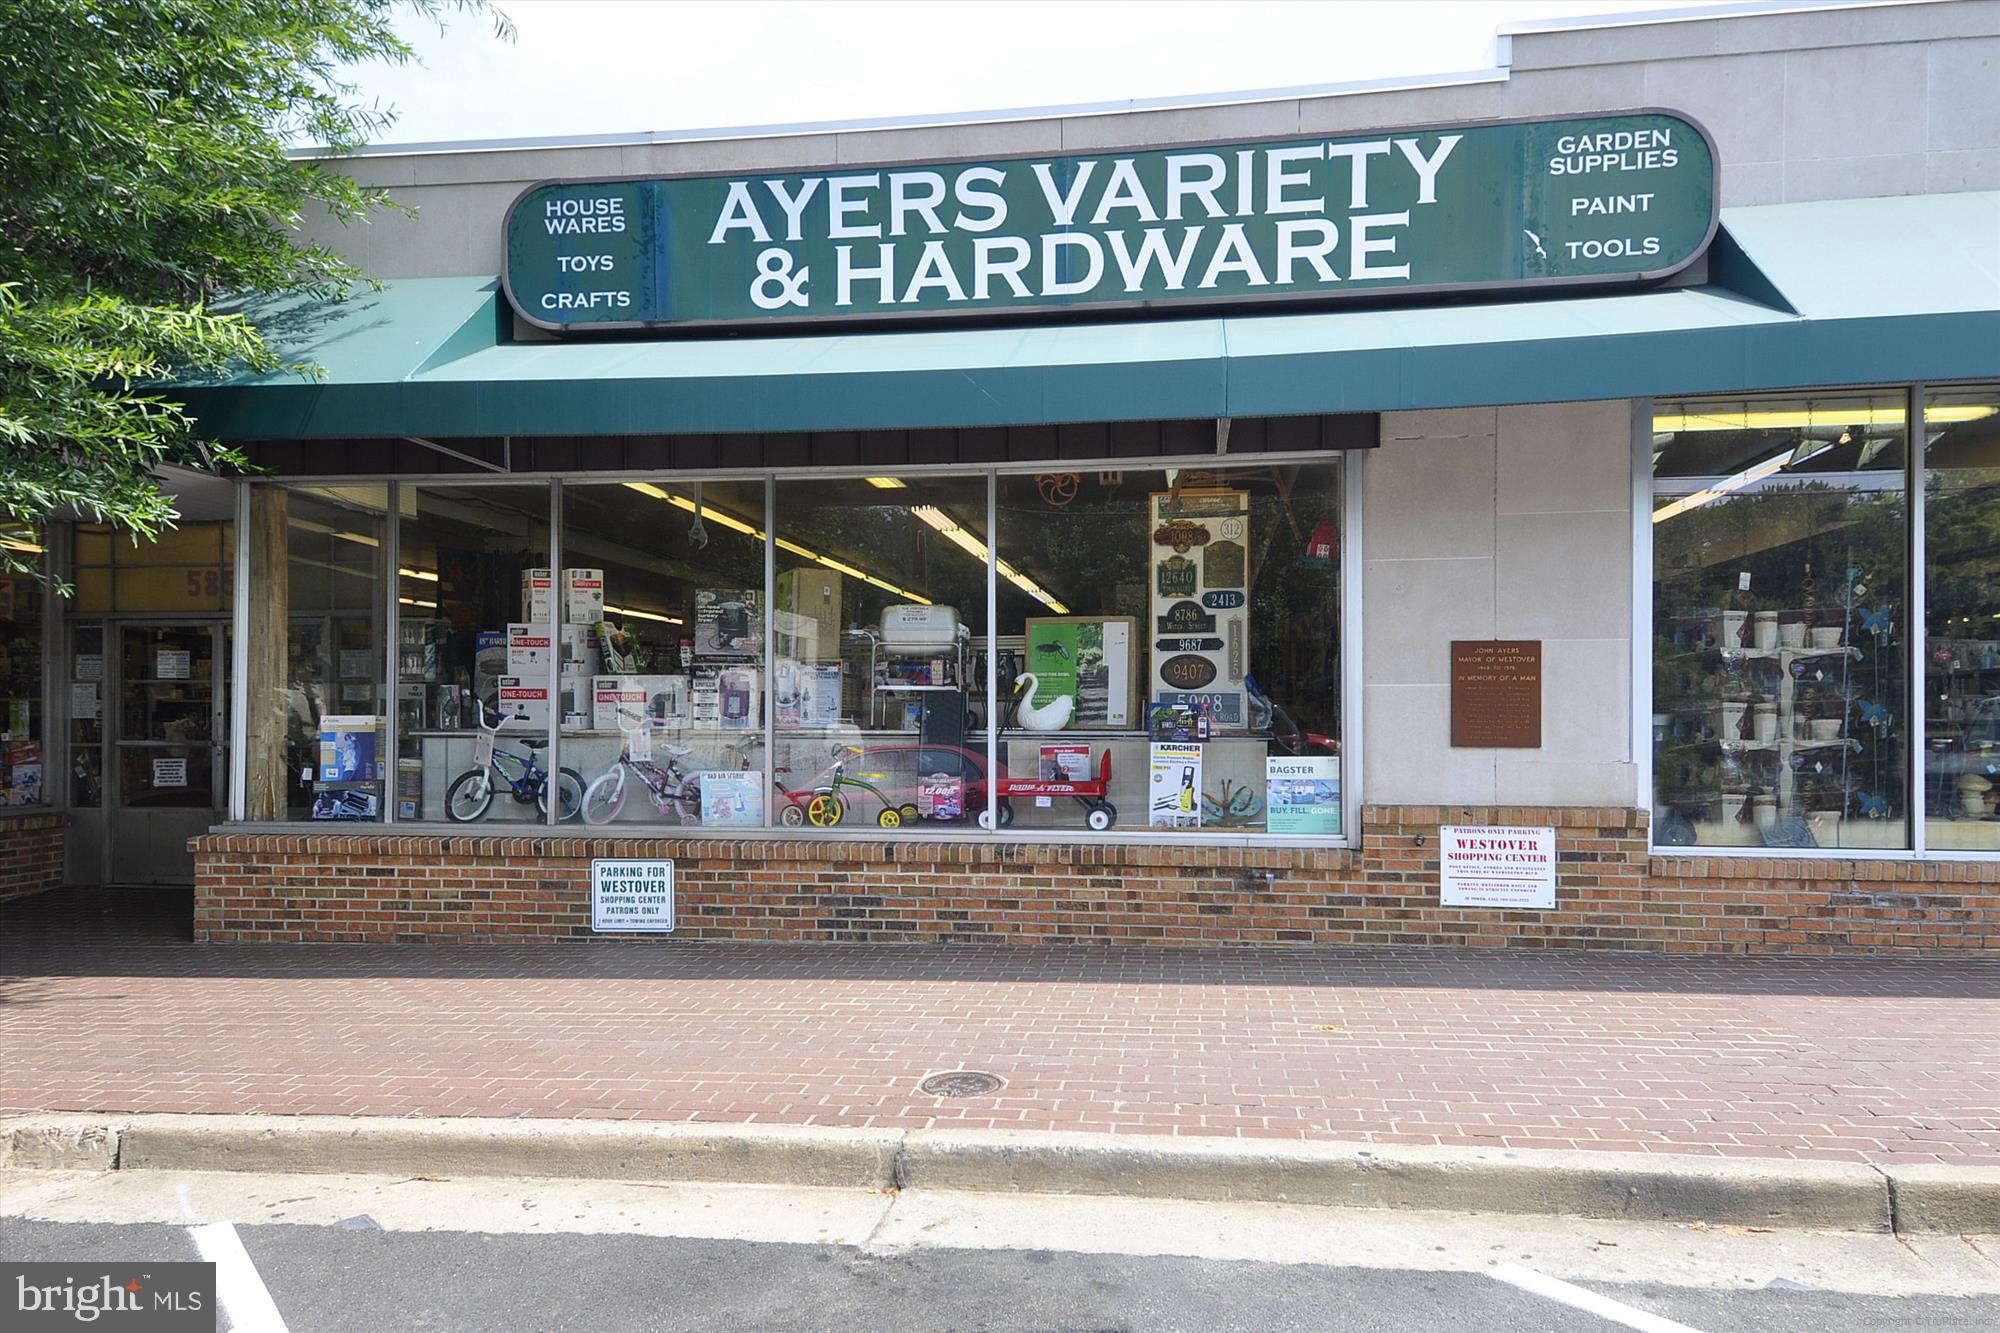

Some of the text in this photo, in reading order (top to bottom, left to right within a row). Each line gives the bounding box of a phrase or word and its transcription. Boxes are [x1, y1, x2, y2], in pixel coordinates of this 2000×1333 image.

[1557, 128, 1671, 153] GARDEN
[1549, 149, 1678, 176] SUPPLIES
[707, 135, 1463, 244] AYERS VARIETY
[546, 198, 624, 217] HOUSE
[1571, 193, 1654, 216] PAINT
[544, 217, 626, 234] WARES
[1566, 237, 1660, 259] TOOLS
[557, 256, 614, 273] TOYS
[750, 210, 1410, 309] & HARDWARE
[541, 292, 631, 310] CRAFTS
[1224, 523, 1240, 535] 312
[1161, 572, 1192, 583] 12640
[1212, 594, 1236, 606] 2413
[1175, 609, 1197, 620] 8786
[1179, 639, 1202, 650] 9687
[1173, 664, 1204, 680] 9407
[1270, 766, 1314, 774] BAGSTER
[1457, 839, 1538, 850] WESTOVER
[1448, 853, 1547, 862] SHOPPING CENTER
[601, 867, 665, 877] PARKING FOR
[601, 881, 665, 893] WESTOVER
